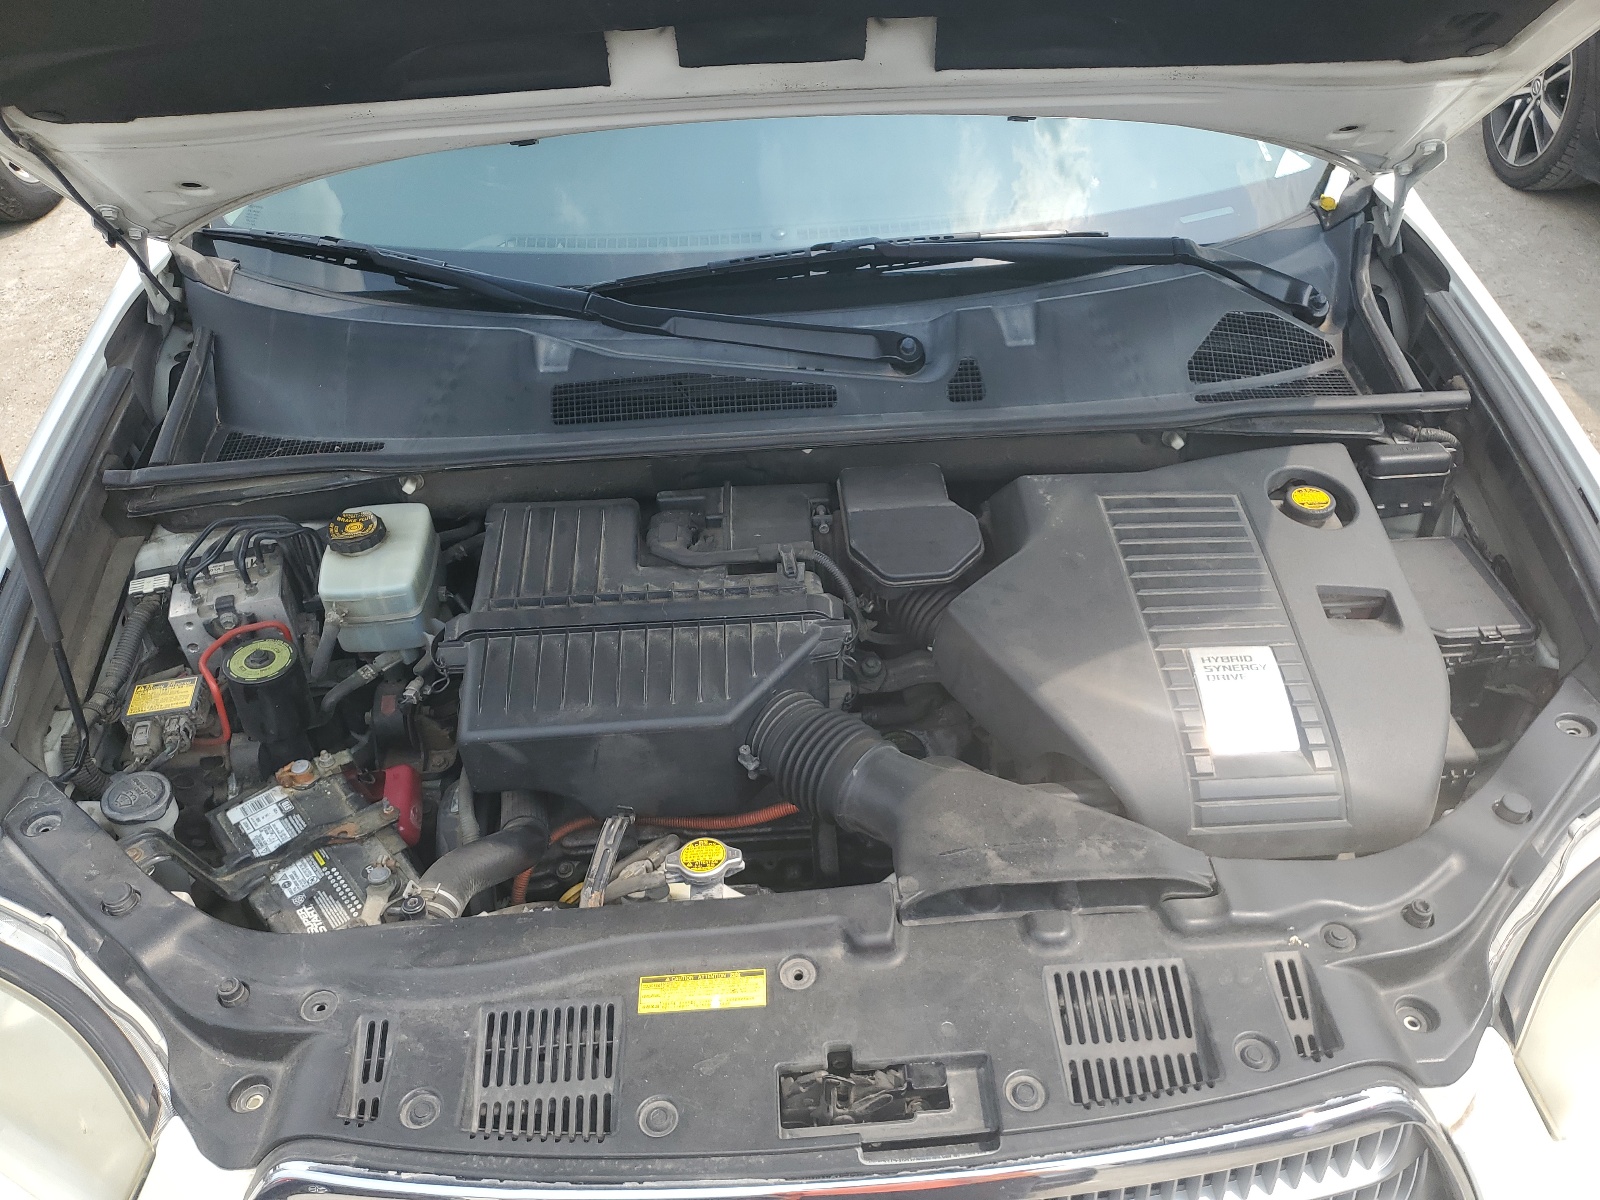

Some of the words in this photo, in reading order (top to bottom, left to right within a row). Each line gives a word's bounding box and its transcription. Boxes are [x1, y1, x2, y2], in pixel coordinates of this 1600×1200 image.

[1200, 655, 1253, 664] HYBRID
[1203, 663, 1267, 673] SYNERGY
[296, 904, 320, 934] SUPER
[303, 903, 328, 933] START
